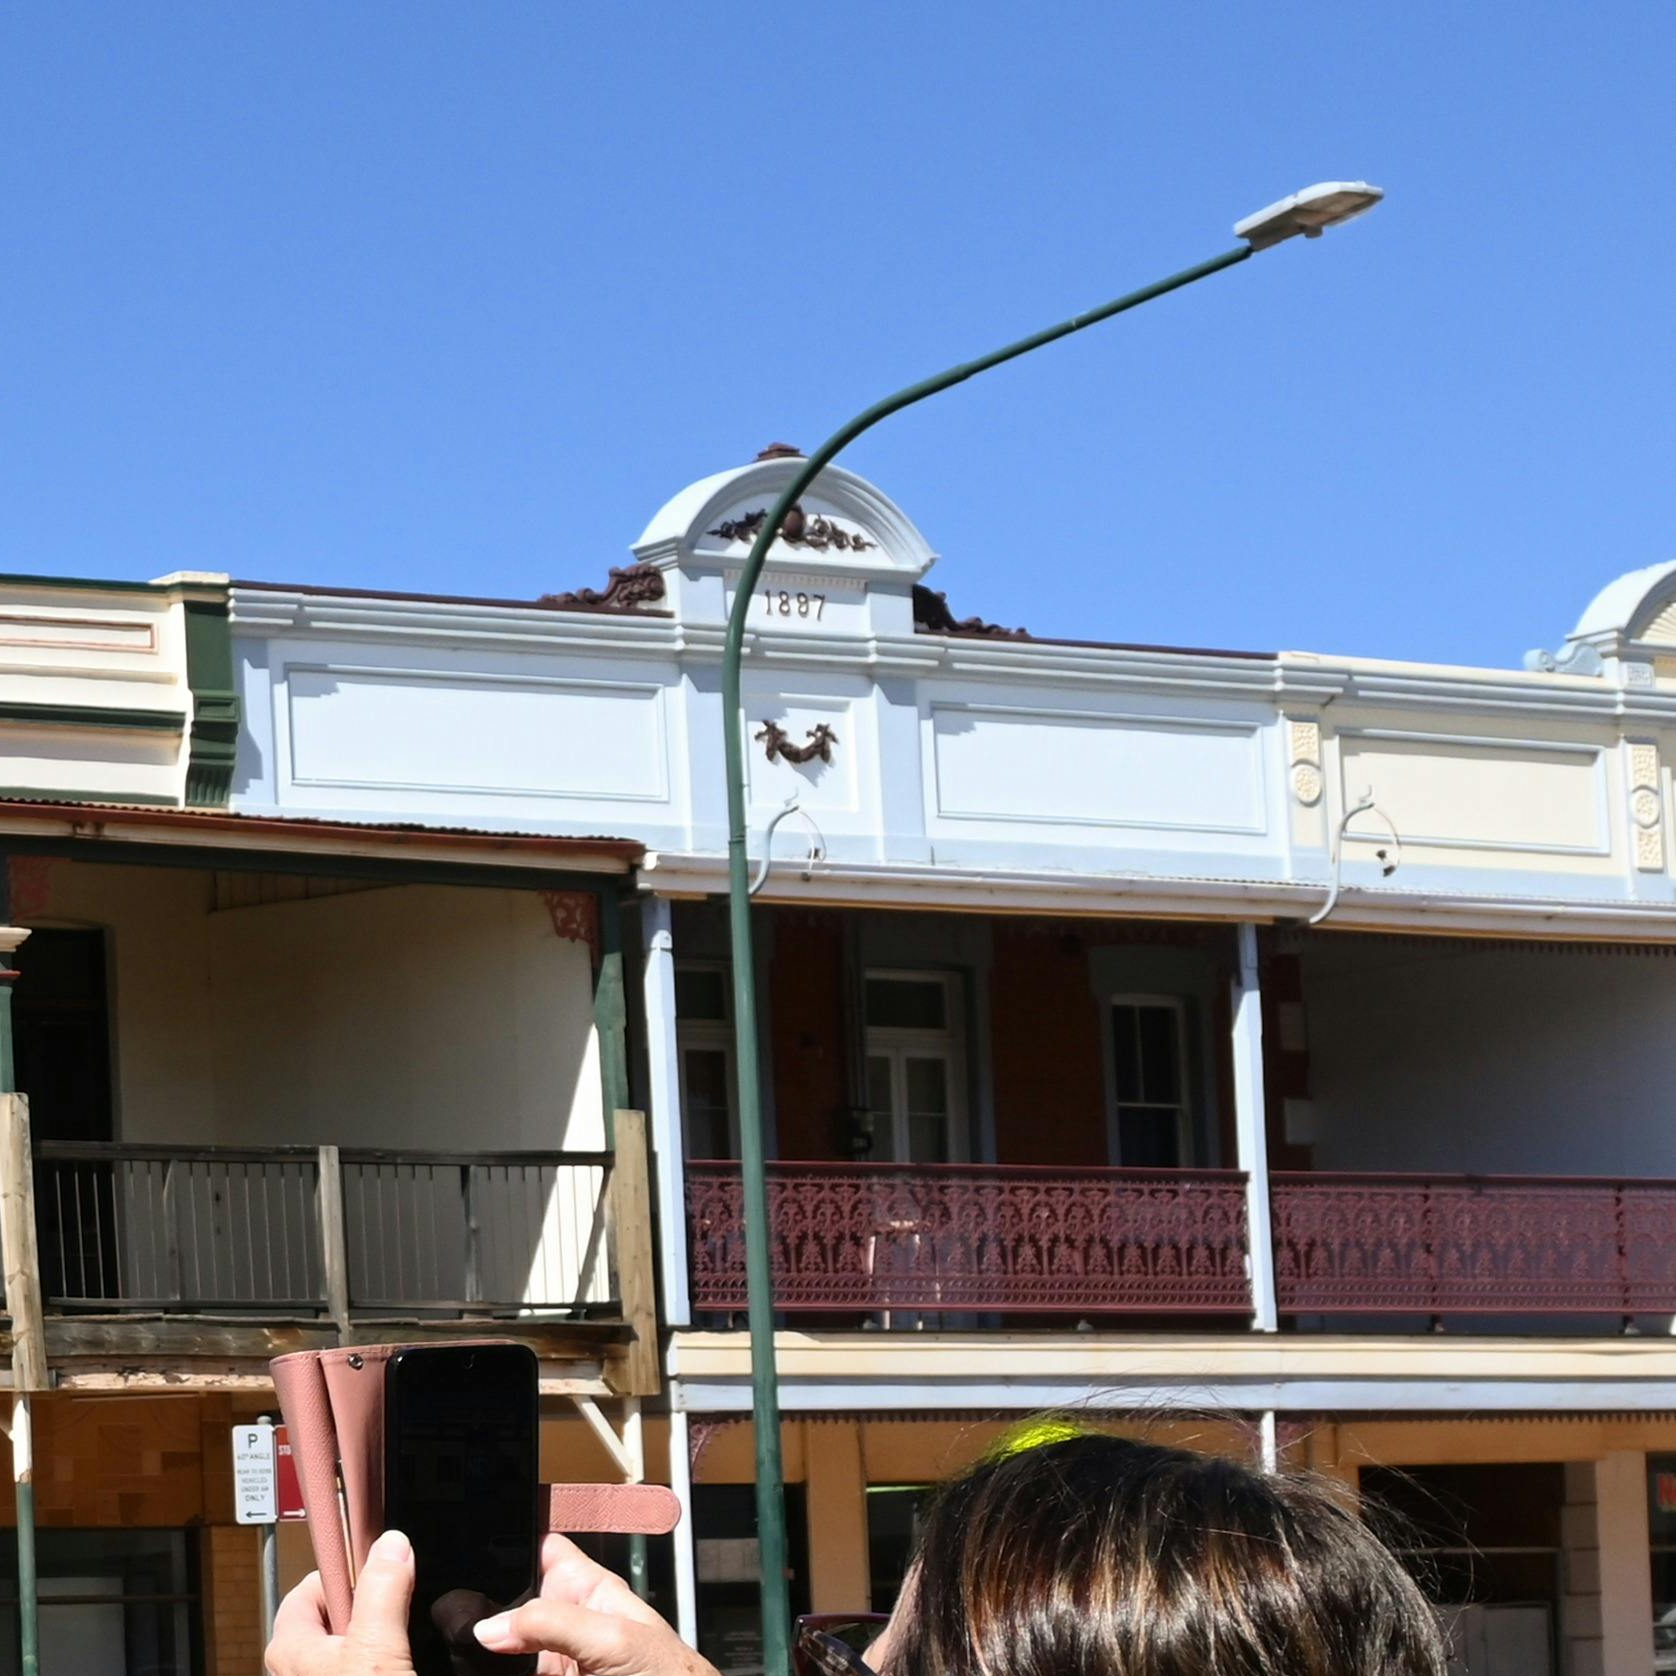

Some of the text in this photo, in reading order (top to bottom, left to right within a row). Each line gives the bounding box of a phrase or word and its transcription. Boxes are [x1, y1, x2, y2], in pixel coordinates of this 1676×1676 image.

[765, 589, 826, 622] 1887
[248, 1433, 258, 1449] P
[245, 1494, 266, 1502] ONLY
